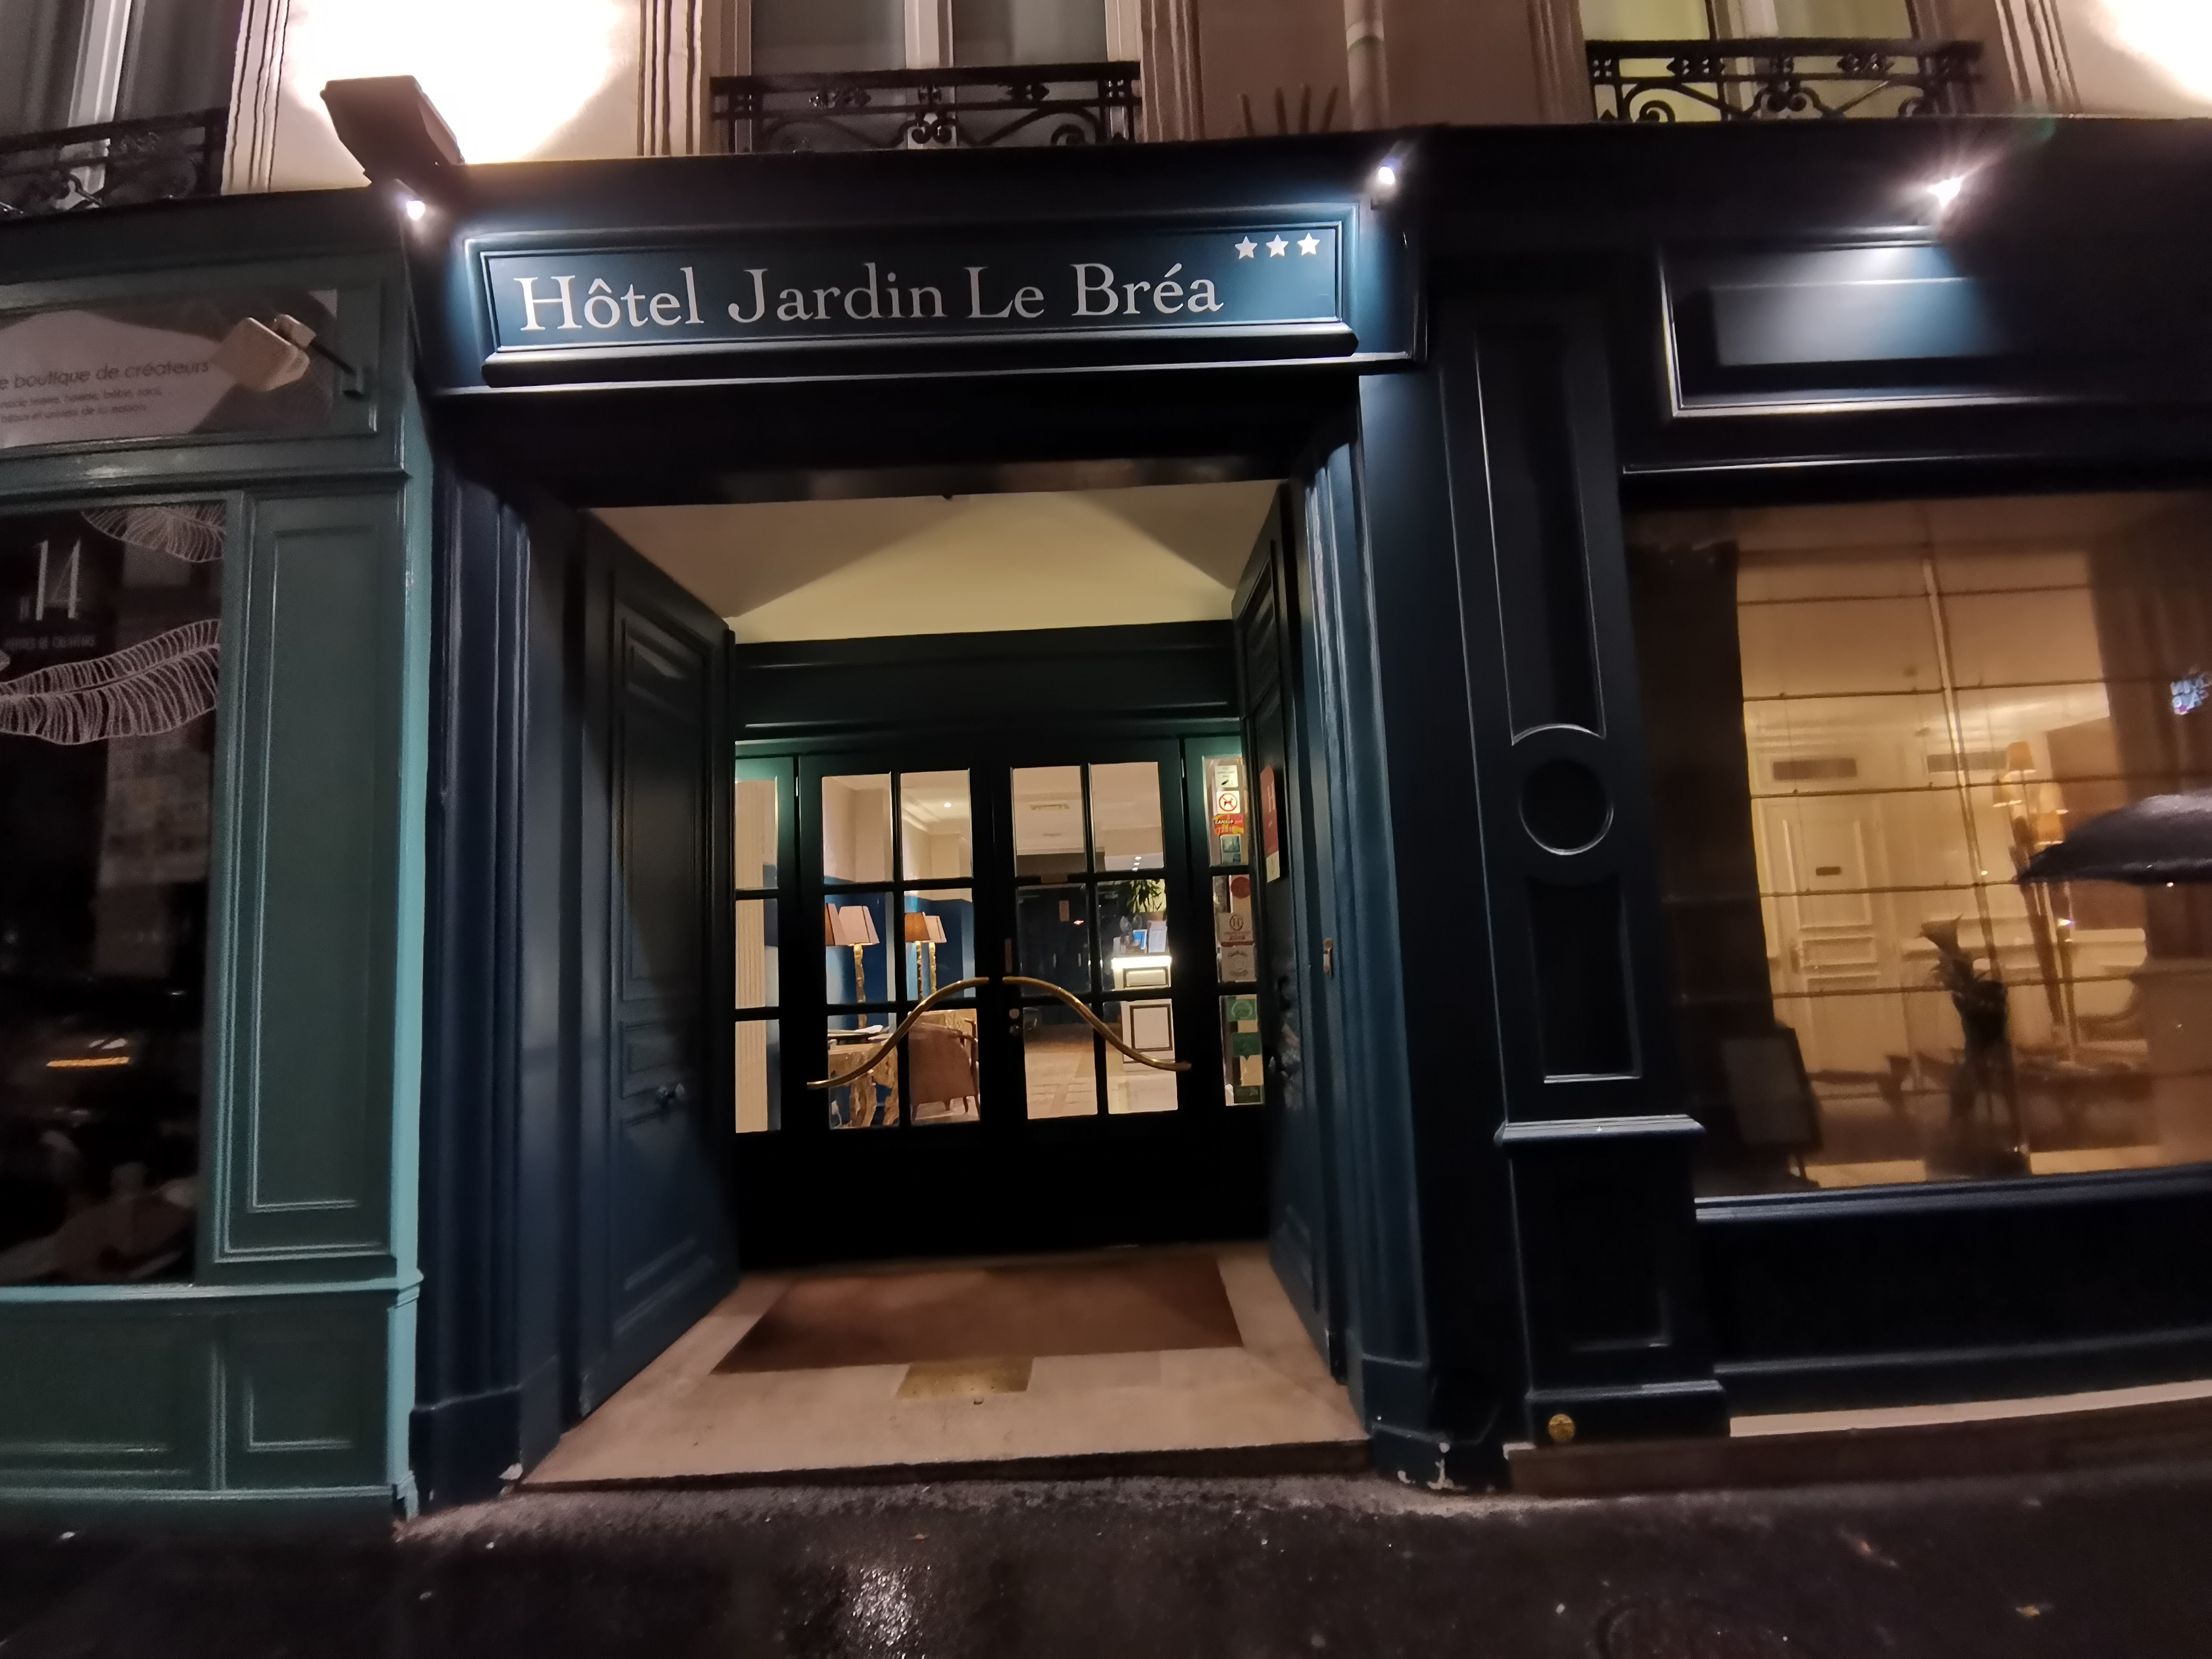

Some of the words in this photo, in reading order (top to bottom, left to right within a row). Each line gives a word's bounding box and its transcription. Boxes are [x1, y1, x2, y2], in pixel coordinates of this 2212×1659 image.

[513, 266, 704, 331] Hôtel
[728, 262, 948, 323] Jardin
[964, 266, 1045, 318] Le
[1069, 263, 1224, 316] Bréa
[14, 370, 91, 388] boutique
[96, 363, 120, 380] de
[125, 361, 208, 378] créateurs
